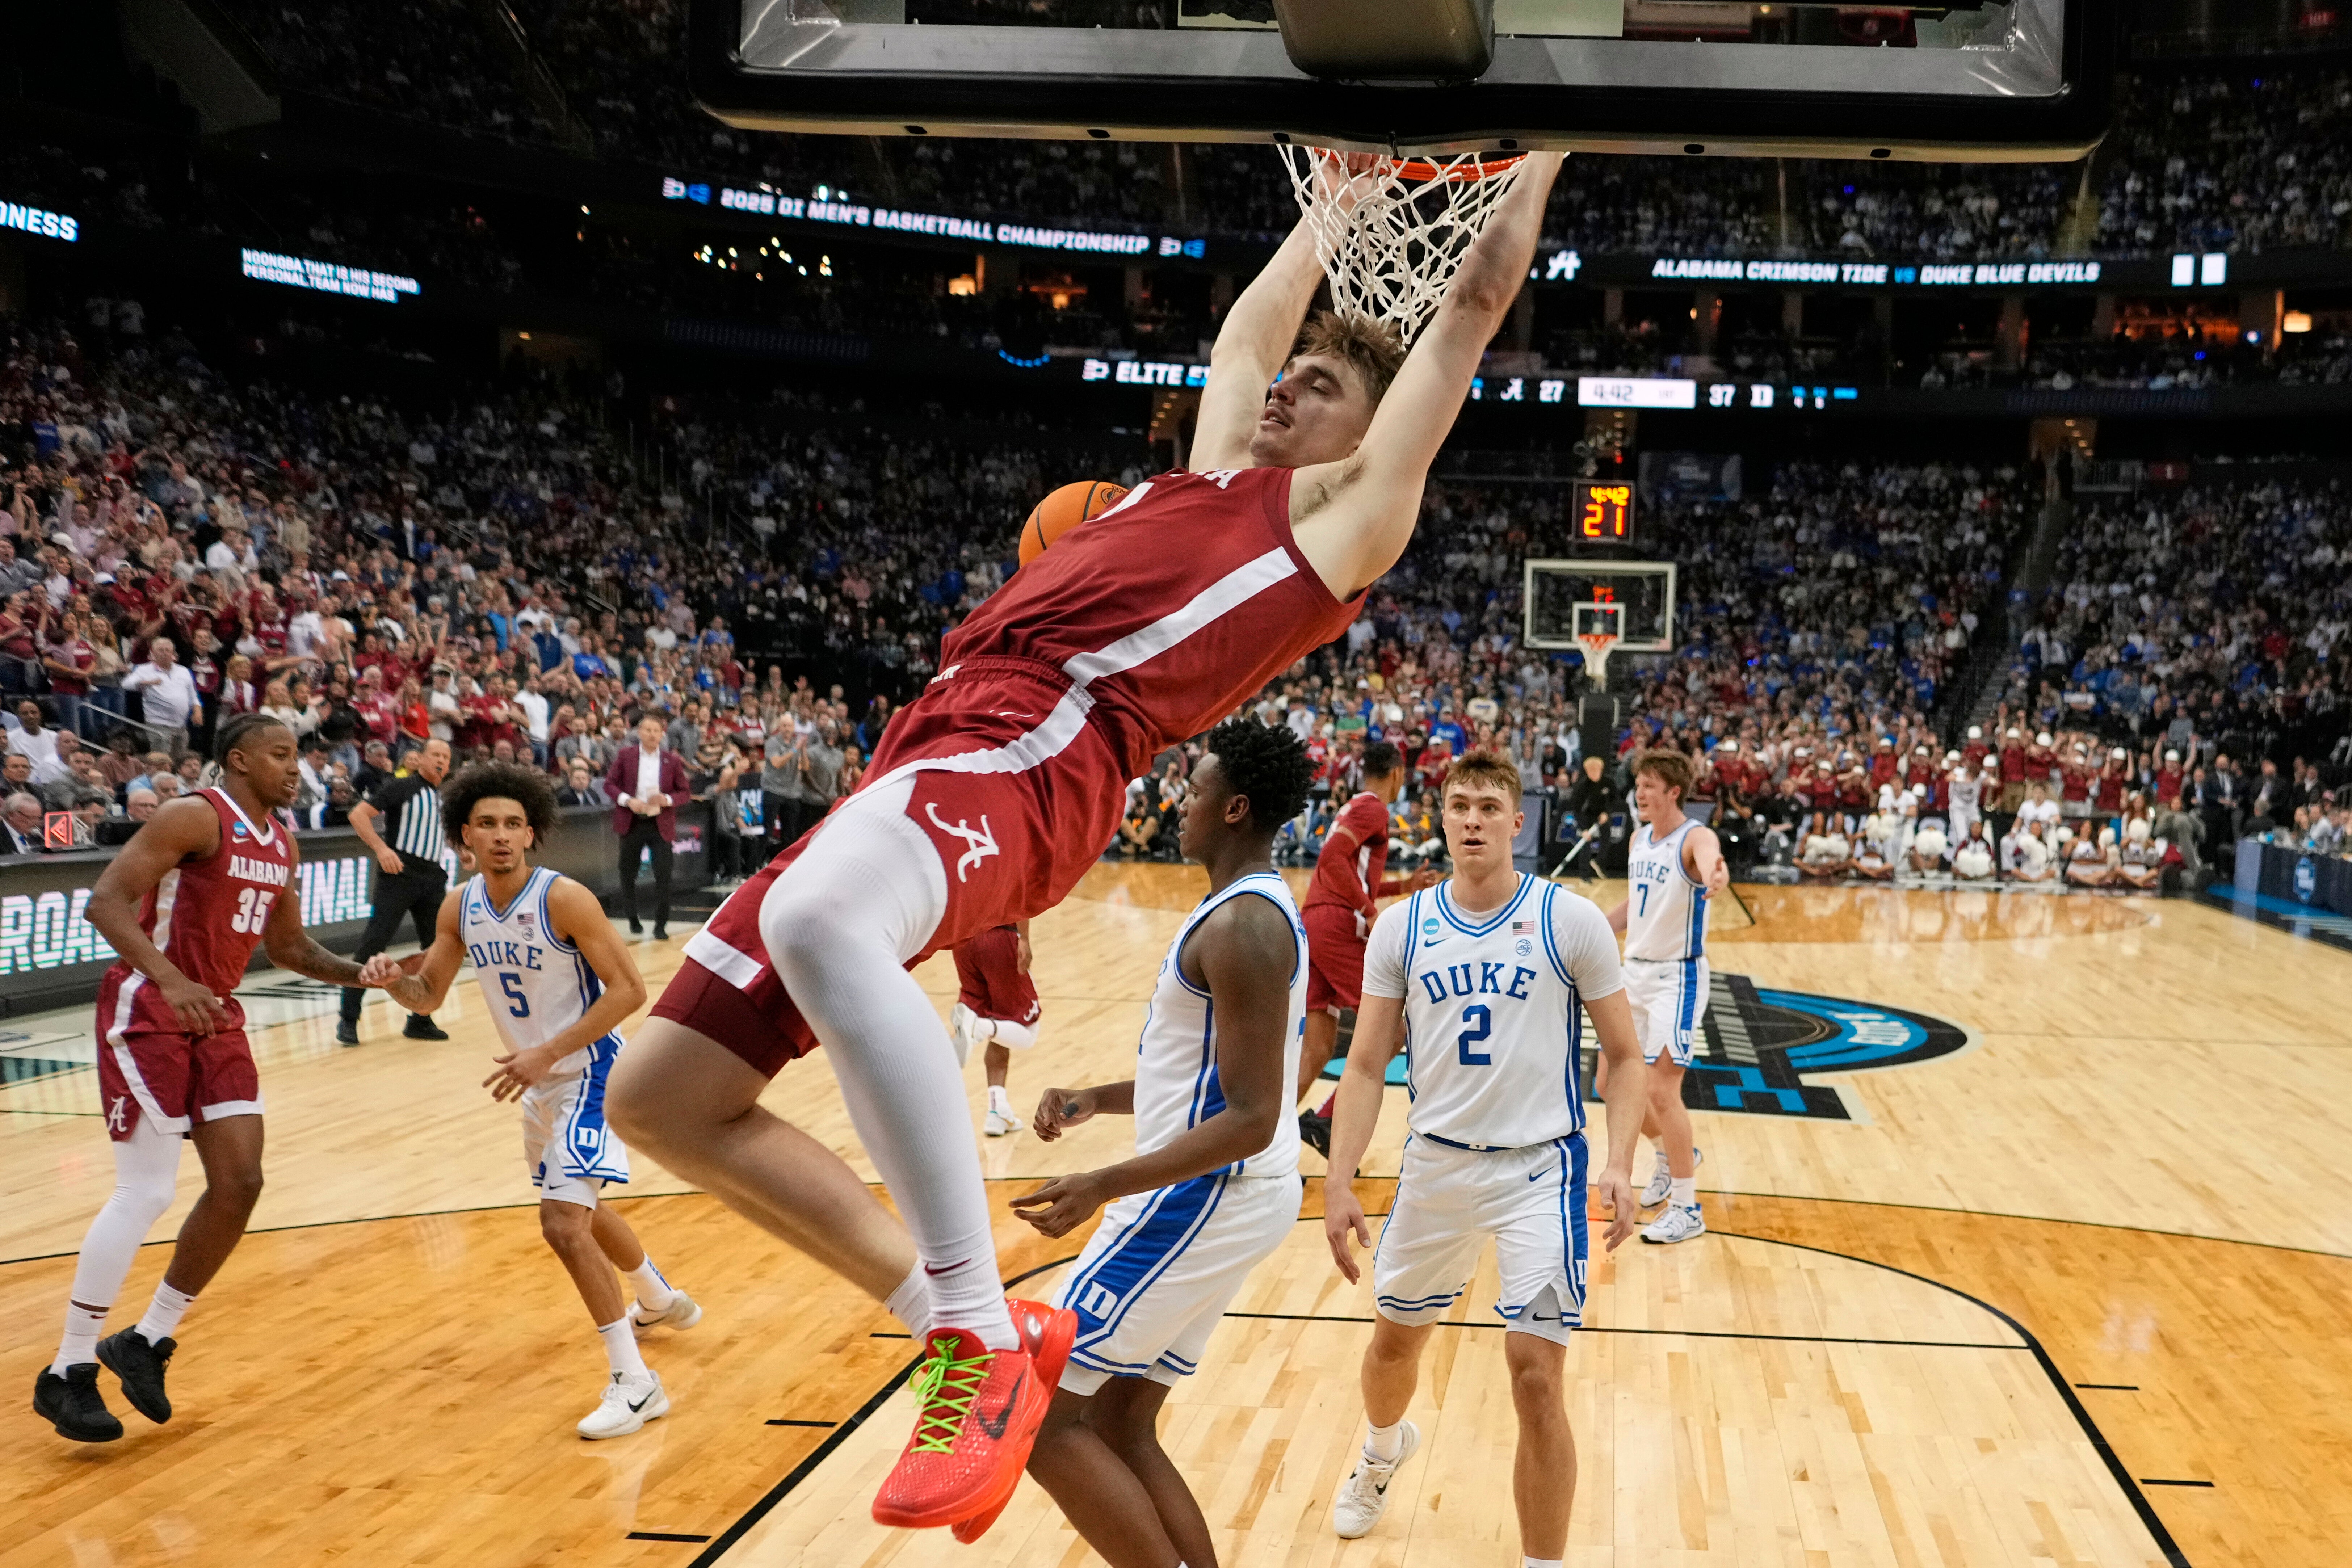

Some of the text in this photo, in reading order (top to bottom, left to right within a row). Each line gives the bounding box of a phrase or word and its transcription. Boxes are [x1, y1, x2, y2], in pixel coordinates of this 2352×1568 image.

[721, 188, 1150, 253] 2025 DI MEN'S BASKETBALL CHAMPIONSHIP
[303, 259, 335, 277] THAT
[336, 265, 348, 281] IS
[350, 268, 370, 285] HIS
[371, 272, 420, 295] SECOND
[308, 274, 341, 293] TEAM
[342, 283, 370, 298] NOW
[371, 287, 397, 303] HAS
[1652, 259, 2100, 284] ALABAMA CRIMSON TIDE VS DUKE BLUE DEVILS
[1116, 361, 1184, 386] ELITE
[1540, 380, 1564, 402] 27
[1709, 384, 1735, 407] 37
[1590, 487, 1629, 506] 4:42
[1583, 504, 1625, 536] 21
[925, 802, 999, 883] A
[227, 854, 289, 888] ALABAM
[1629, 861, 1670, 883] DUKE
[231, 887, 276, 935] 35
[1637, 883, 1648, 917] 7
[469, 942, 543, 971] DUKE
[499, 972, 530, 1018] 5
[1420, 962, 1537, 1004] DUKE
[1458, 1004, 1491, 1065] 2
[576, 1126, 599, 1148] D
[1078, 1280, 1118, 1320] D
